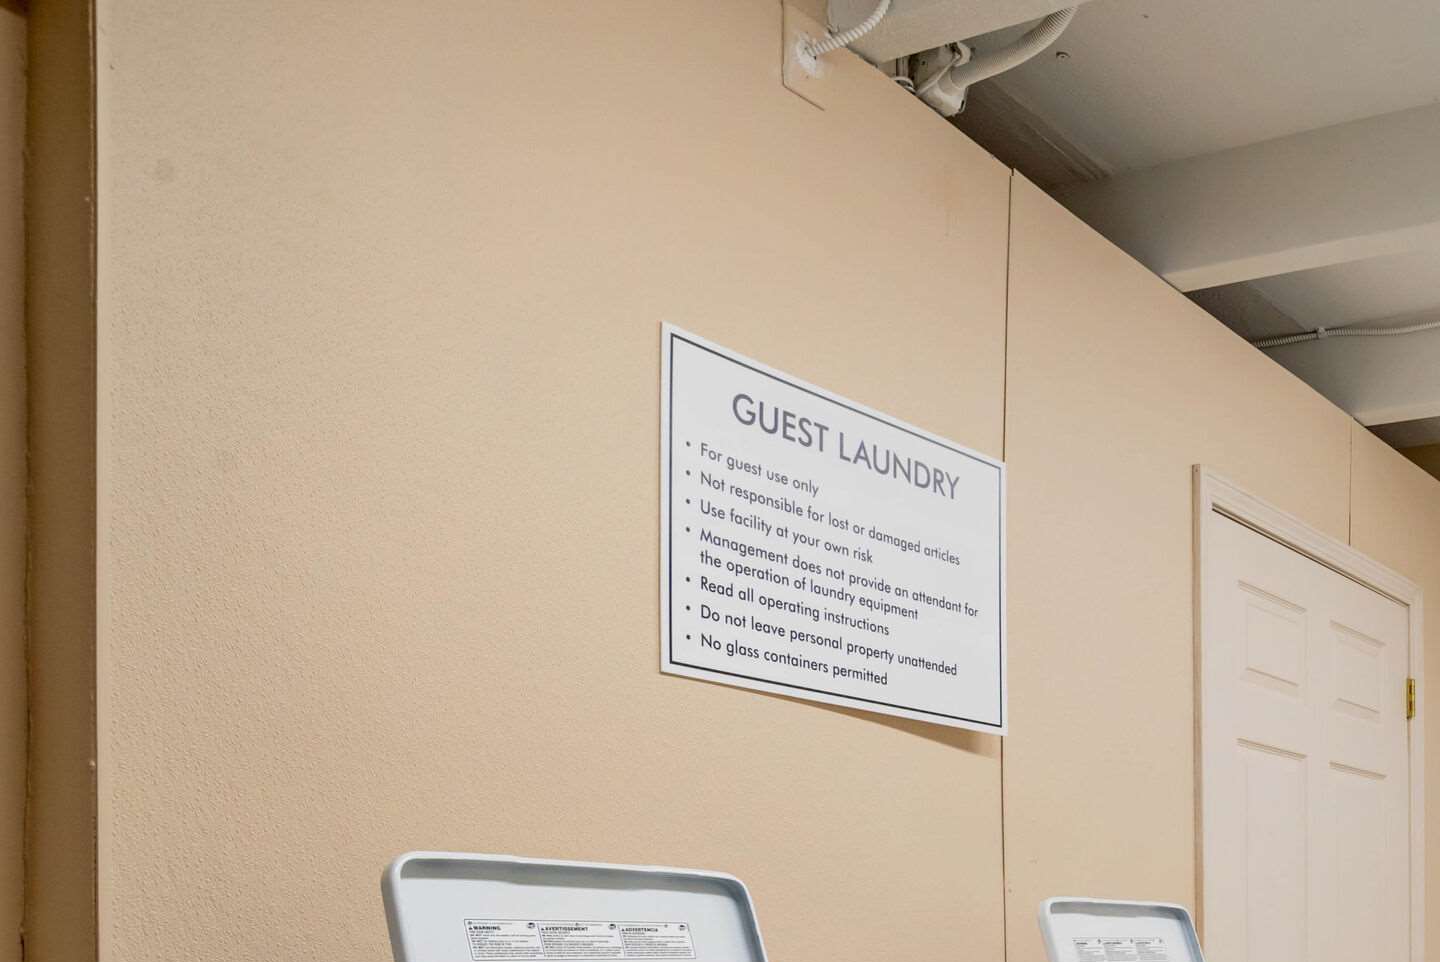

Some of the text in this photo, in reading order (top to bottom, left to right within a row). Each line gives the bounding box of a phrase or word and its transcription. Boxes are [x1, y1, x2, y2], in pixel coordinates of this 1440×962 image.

[700, 442, 819, 498] For guest use only
[732, 393, 960, 500] GUEST LAUNDRY
[700, 471, 961, 566] Not responsible for lost or damaged articles
[700, 498, 873, 564] Use facility at your own risk
[699, 527, 979, 617] Management does not provide an attendant for
[699, 549, 919, 620] the operation of laundry equipment
[700, 575, 890, 636] Read all operating instructions
[700, 603, 958, 676] Do not leave personal property unattended
[700, 632, 888, 686] No glass containers permitted
